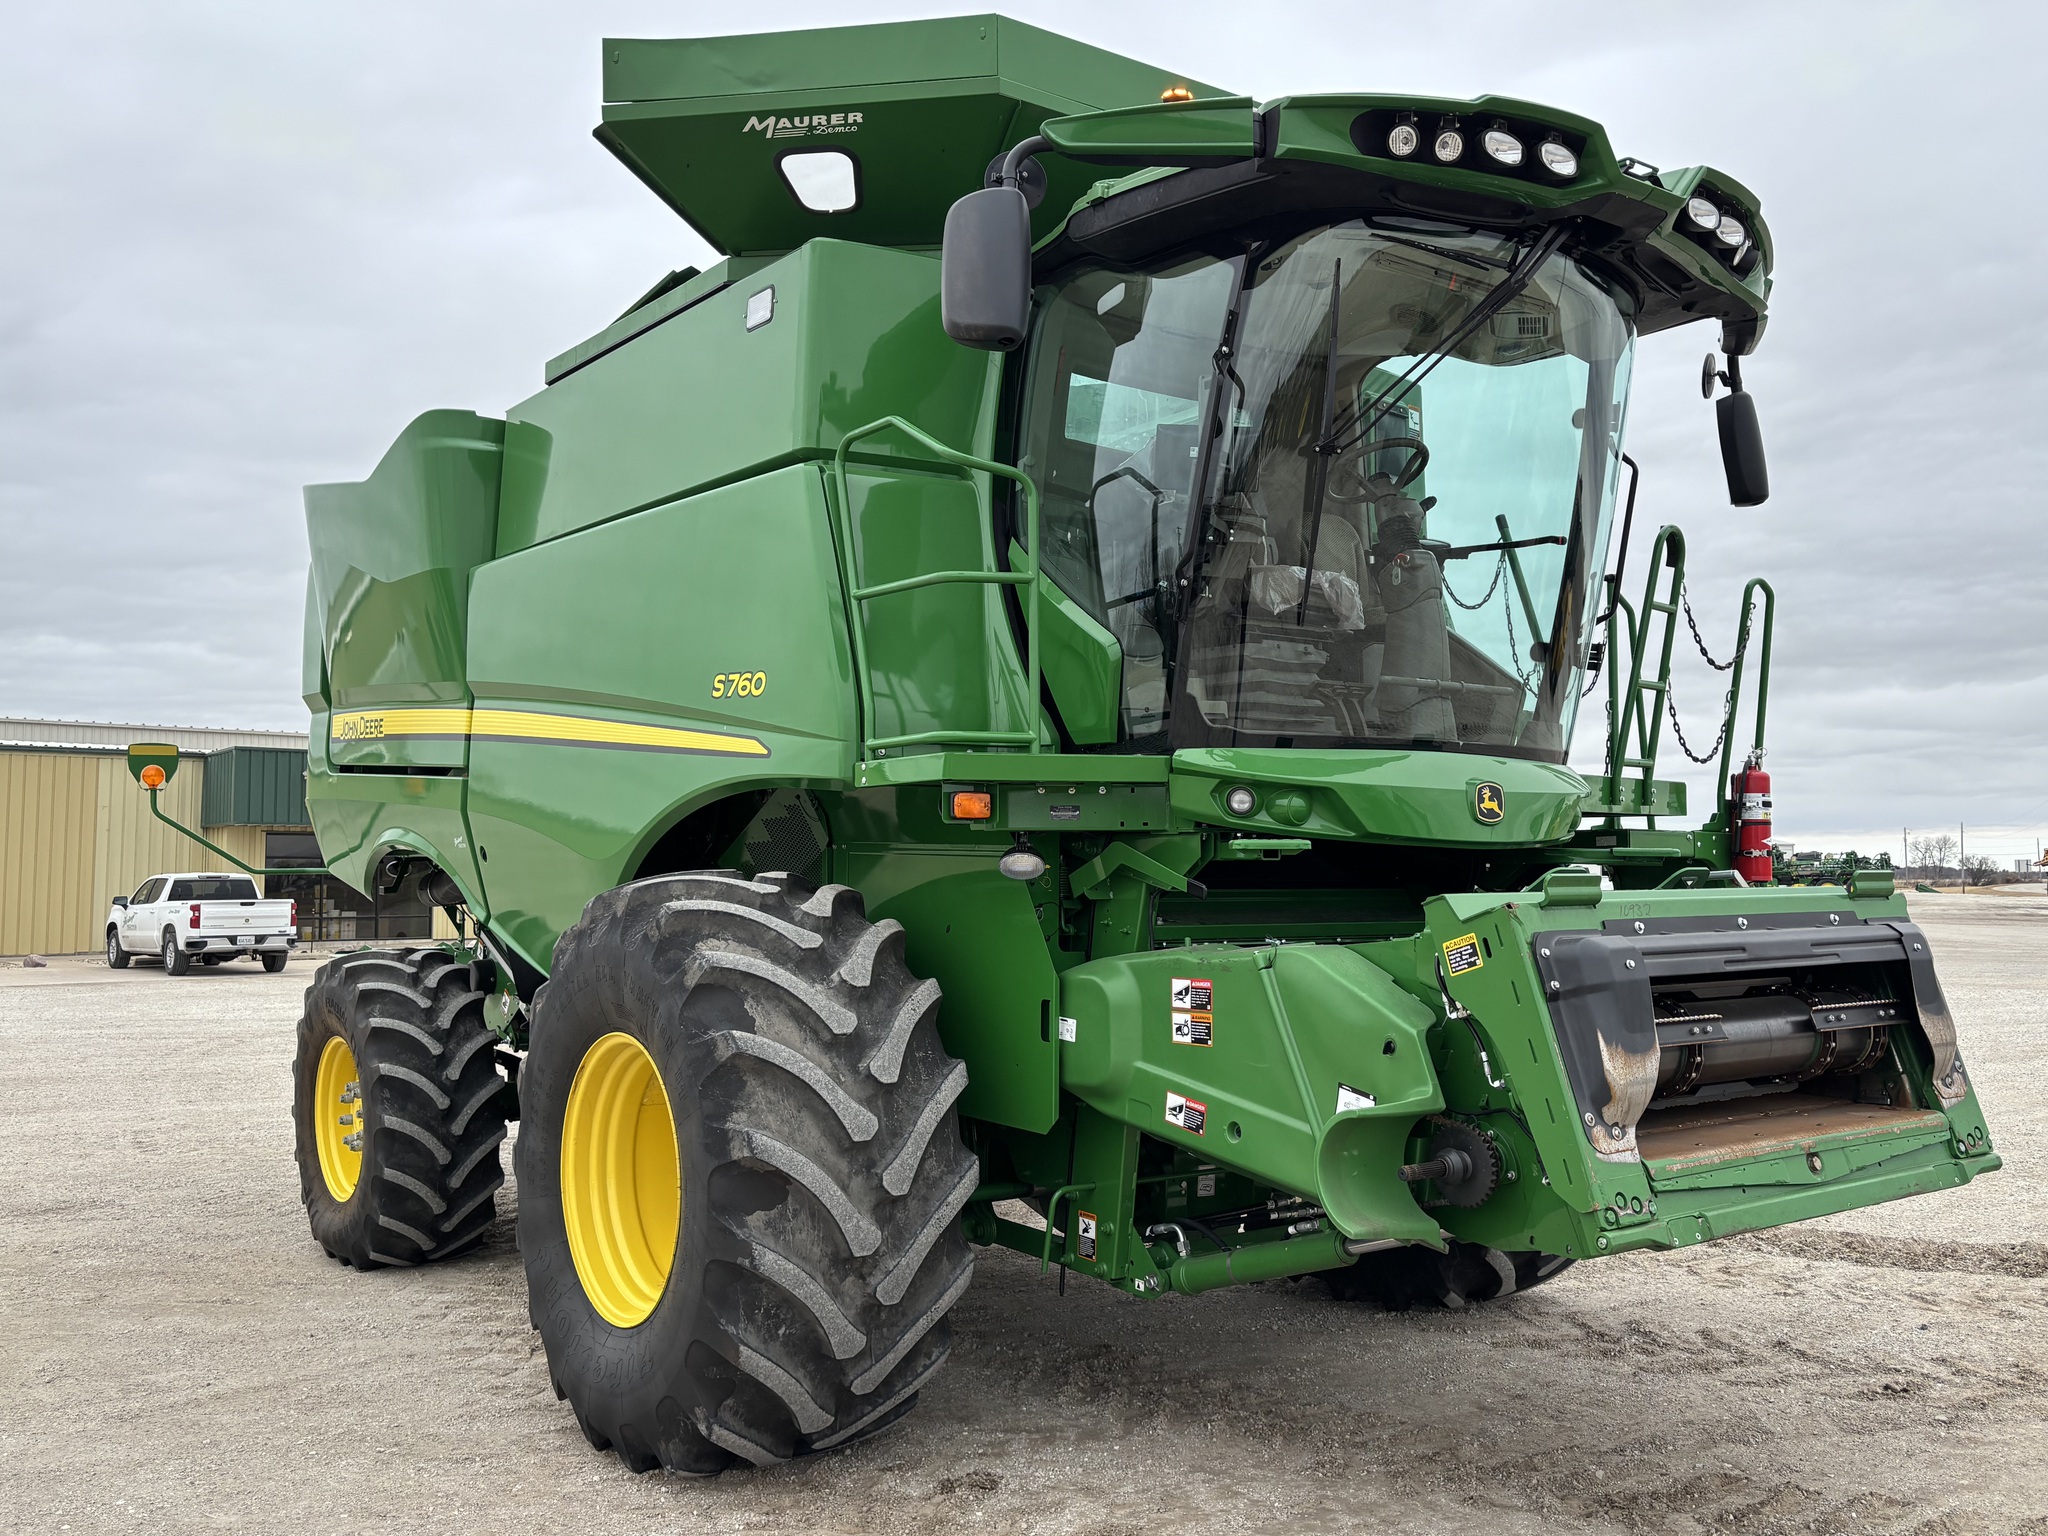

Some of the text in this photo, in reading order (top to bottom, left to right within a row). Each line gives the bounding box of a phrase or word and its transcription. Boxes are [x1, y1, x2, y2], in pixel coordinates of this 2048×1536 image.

[742, 112, 863, 138] MAURER
[813, 125, 857, 134] Demco
[711, 670, 767, 699] S760
[340, 716, 384, 738] JOHN DEERE
[1620, 903, 1651, 917] 10932
[1449, 935, 1475, 949] CAUTION
